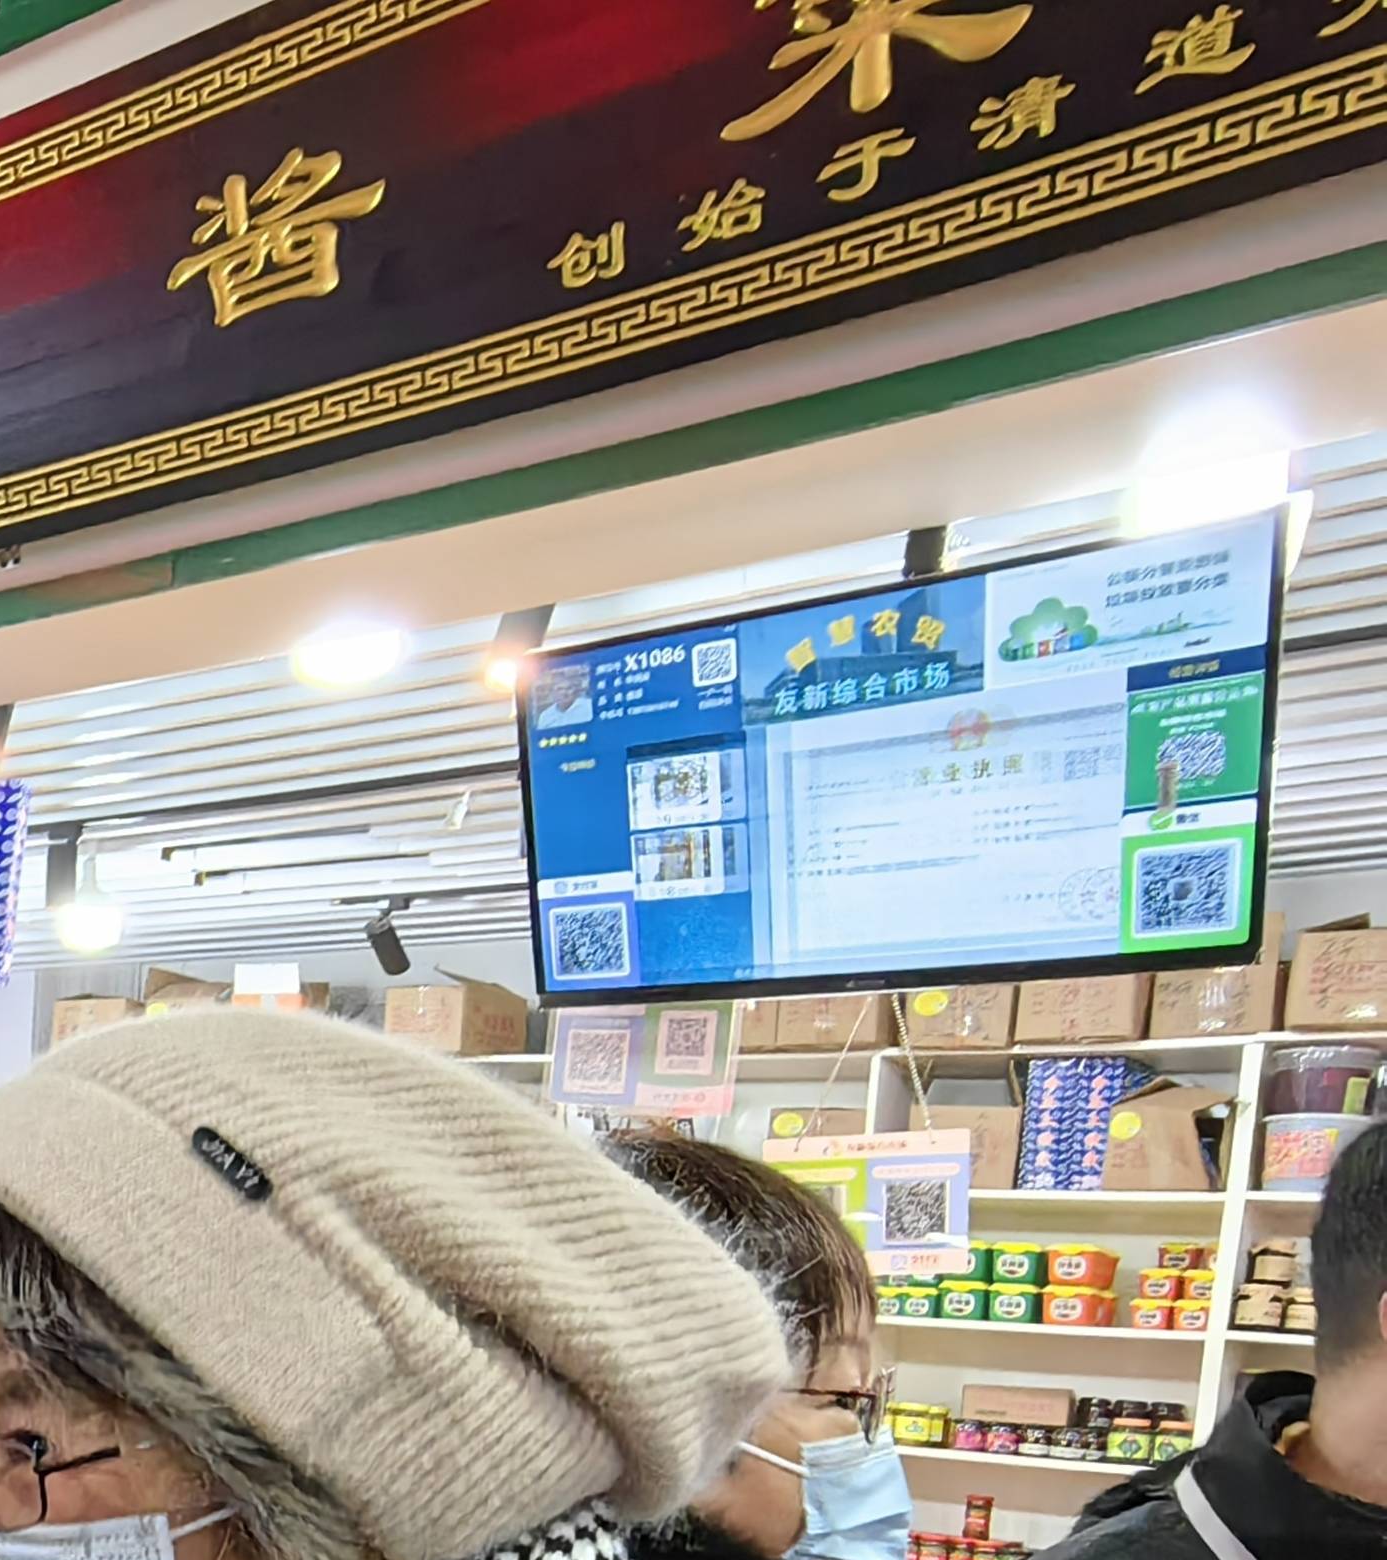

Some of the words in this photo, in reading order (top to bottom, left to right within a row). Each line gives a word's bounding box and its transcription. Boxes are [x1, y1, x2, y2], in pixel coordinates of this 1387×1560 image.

[547, 4, 1387, 288] 创始于清道
[624, 644, 686, 673] X1086
[774, 661, 951, 716] 友新综合市场
